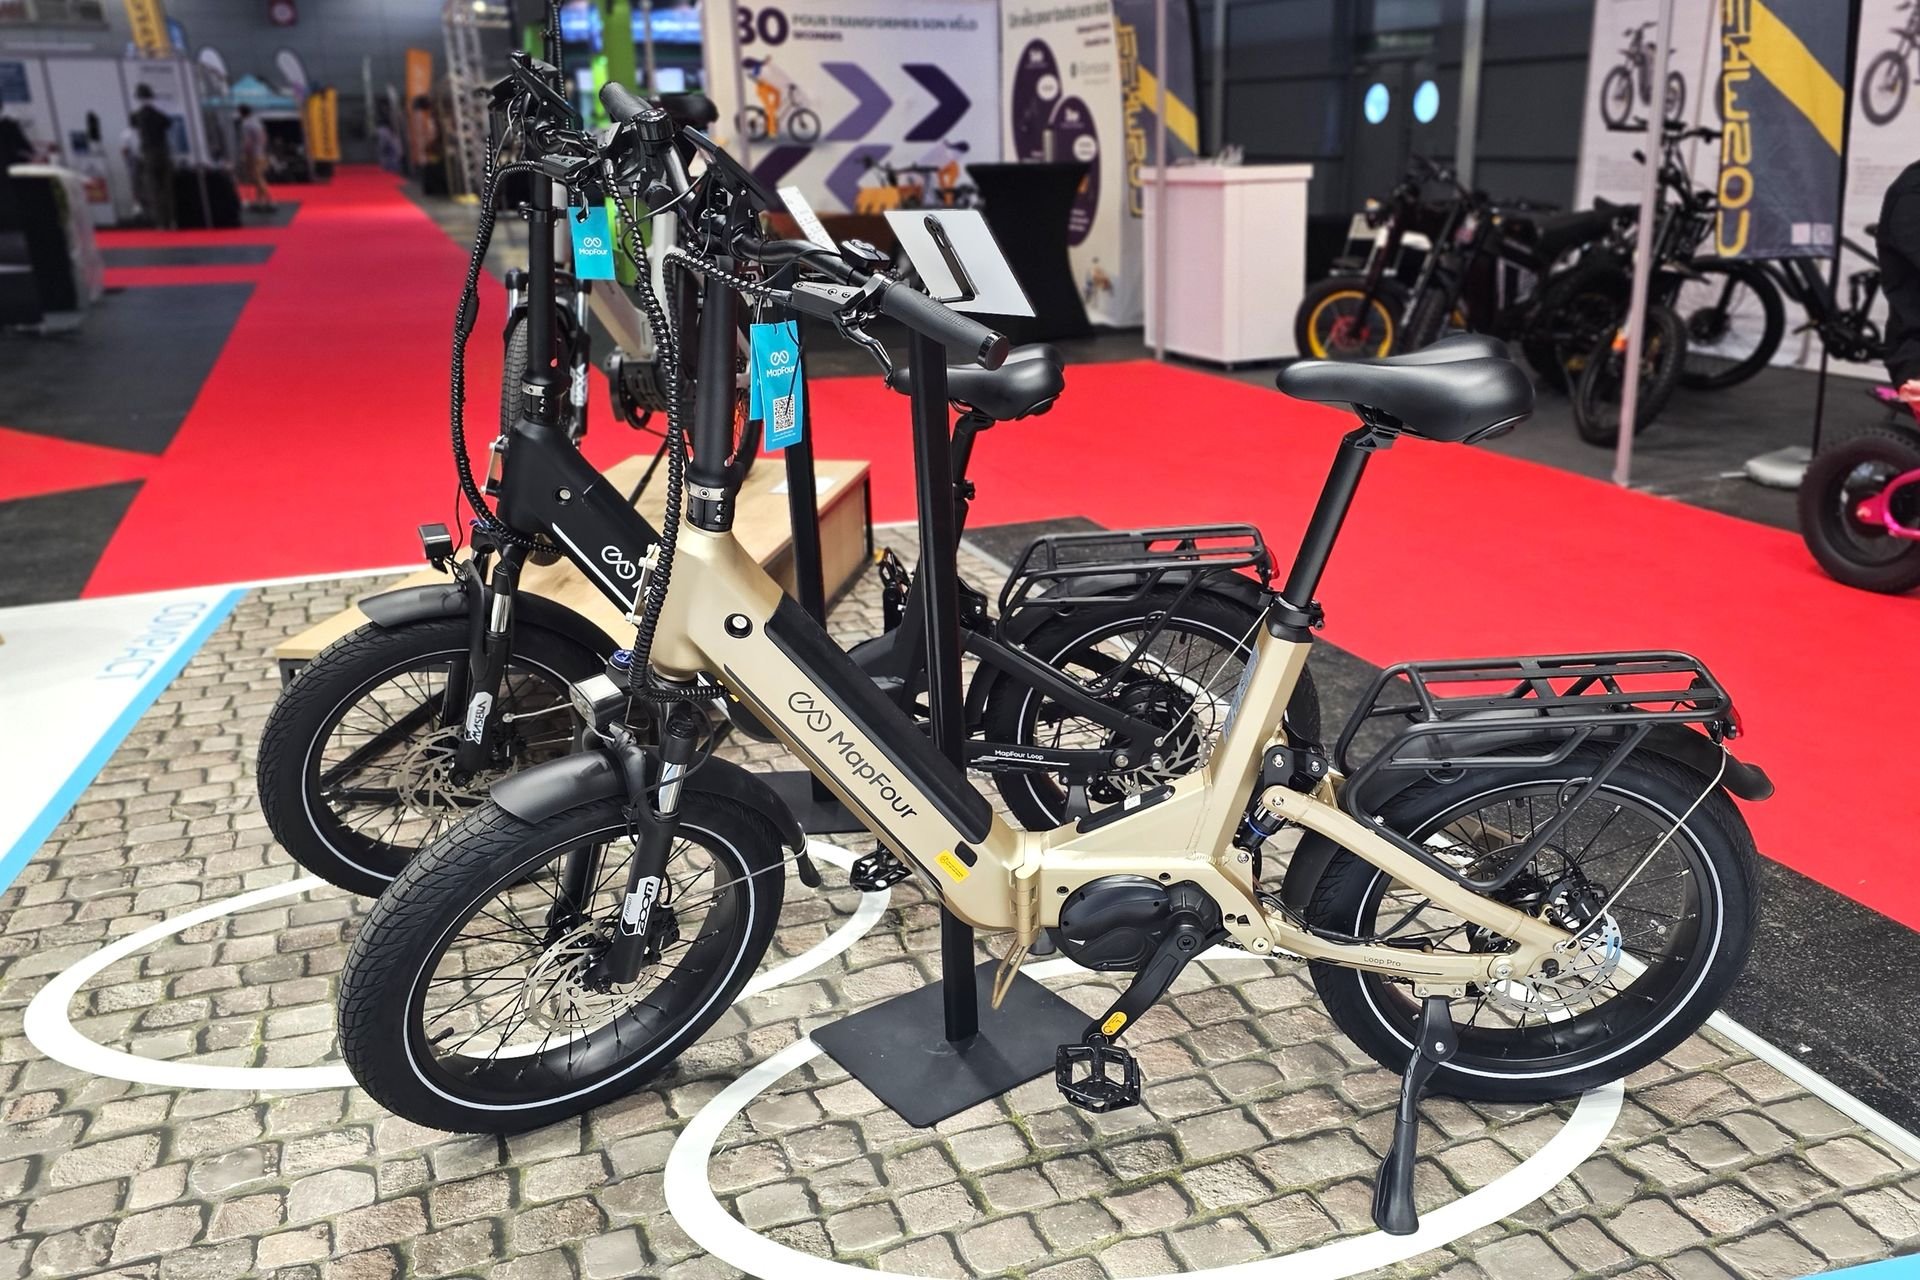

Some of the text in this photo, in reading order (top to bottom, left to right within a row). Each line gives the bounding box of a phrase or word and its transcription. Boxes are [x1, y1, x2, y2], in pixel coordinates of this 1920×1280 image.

[578, 247, 608, 256] MapFour
[766, 365, 796, 378] MapFour
[995, 749, 1044, 761] MapFour Loop
[827, 731, 917, 818] MapFour
[1363, 955, 1402, 967] Loop Pro
